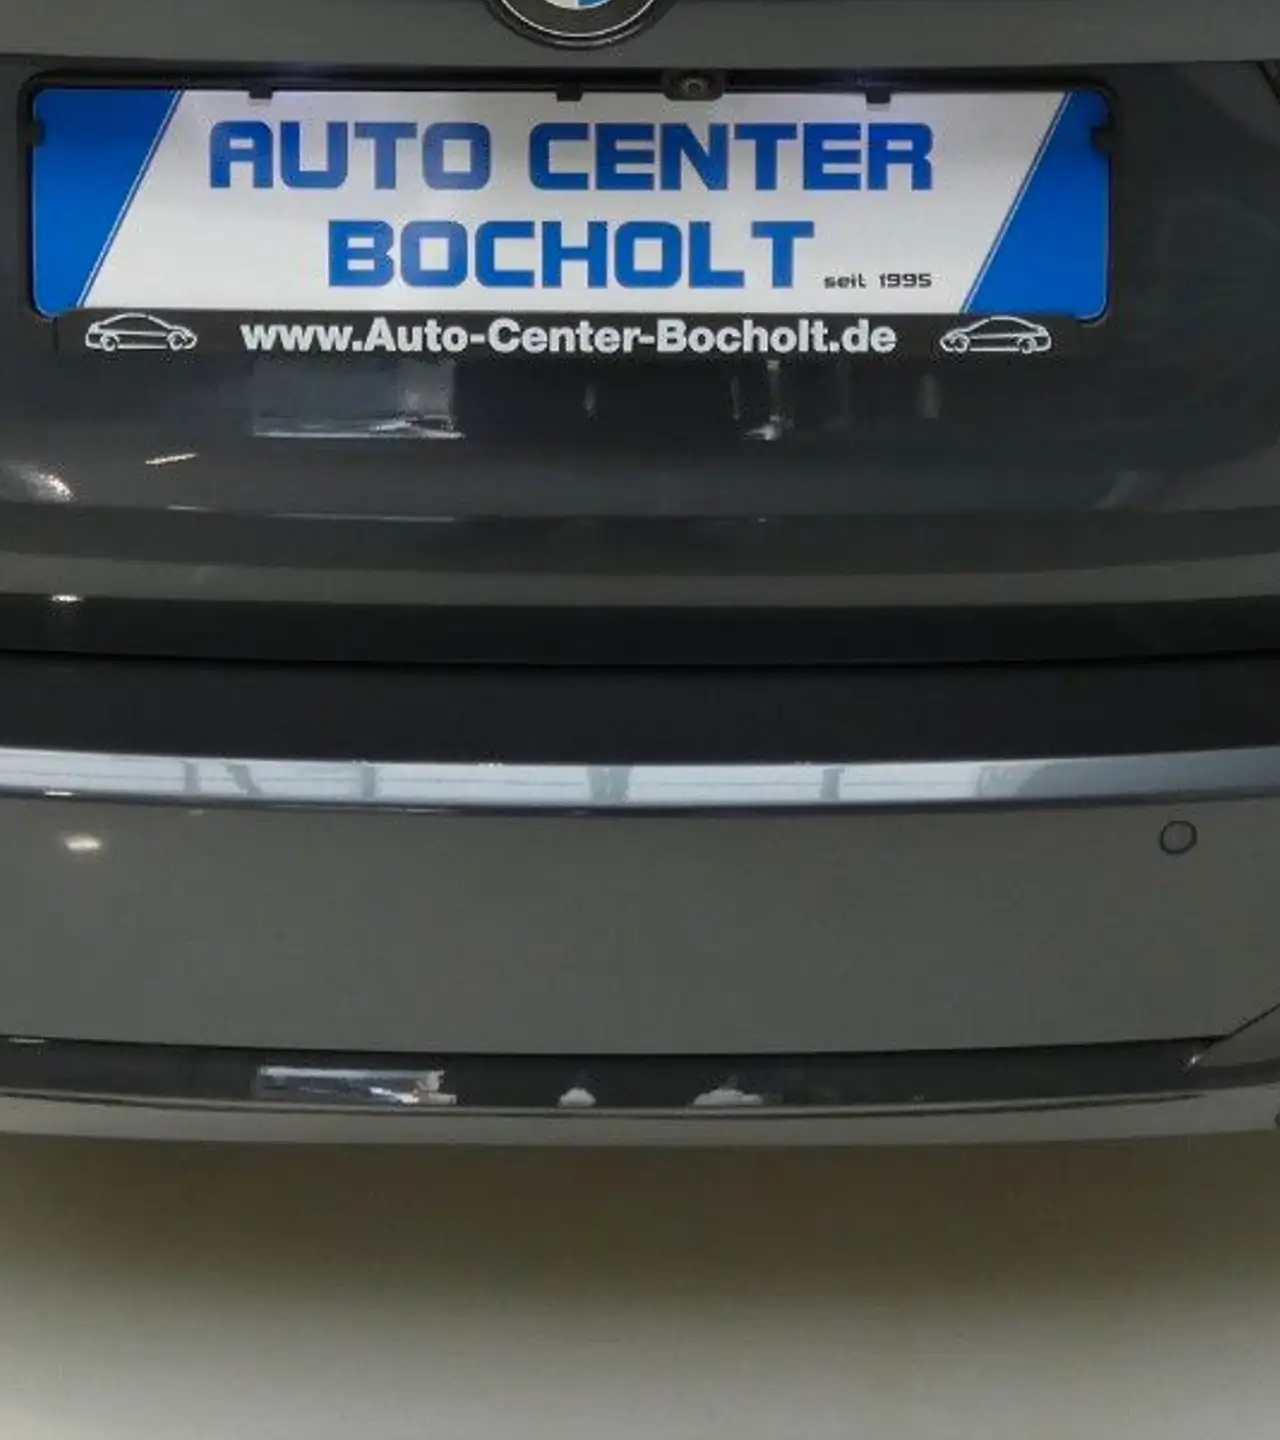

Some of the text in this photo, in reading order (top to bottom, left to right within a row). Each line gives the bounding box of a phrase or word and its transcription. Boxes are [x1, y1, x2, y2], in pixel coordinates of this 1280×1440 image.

[208, 116, 935, 194] AUTO CENTER
[326, 217, 816, 291] BOCHOLT
[823, 272, 933, 289] seit 1995
[240, 315, 898, 356] www.Auto-Center-Bocholt.de
